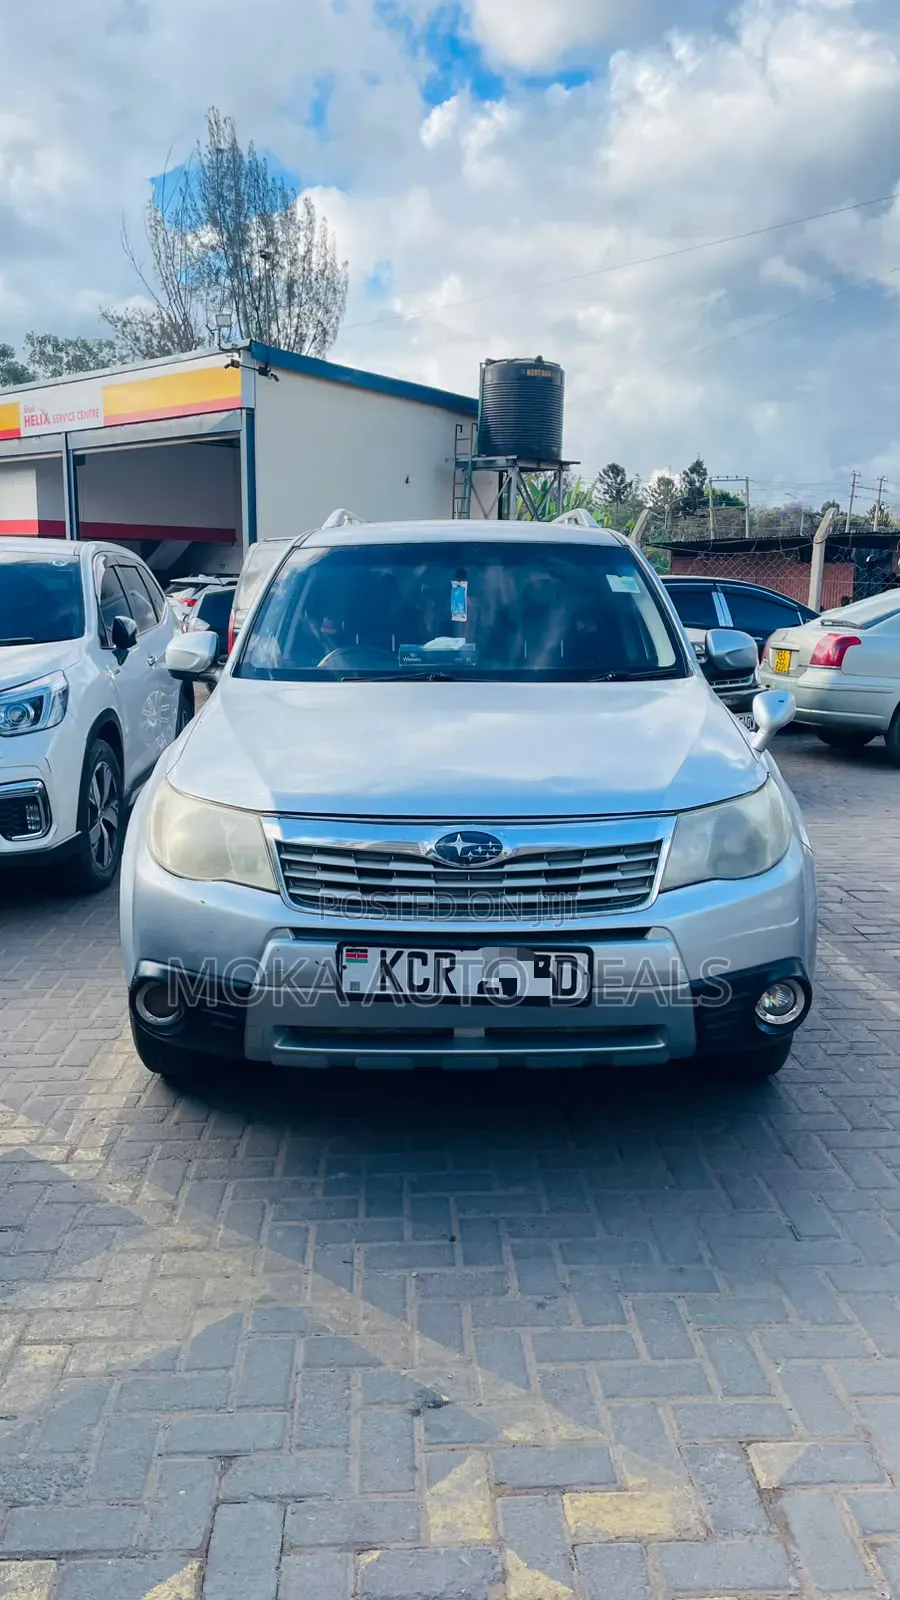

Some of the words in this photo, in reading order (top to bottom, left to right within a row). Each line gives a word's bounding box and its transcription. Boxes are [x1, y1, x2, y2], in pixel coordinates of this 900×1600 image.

[24, 410, 51, 428] HELIX
[52, 411, 75, 424] SERVICE
[77, 408, 99, 421] CENTRE
[380, 949, 457, 994] KCR
